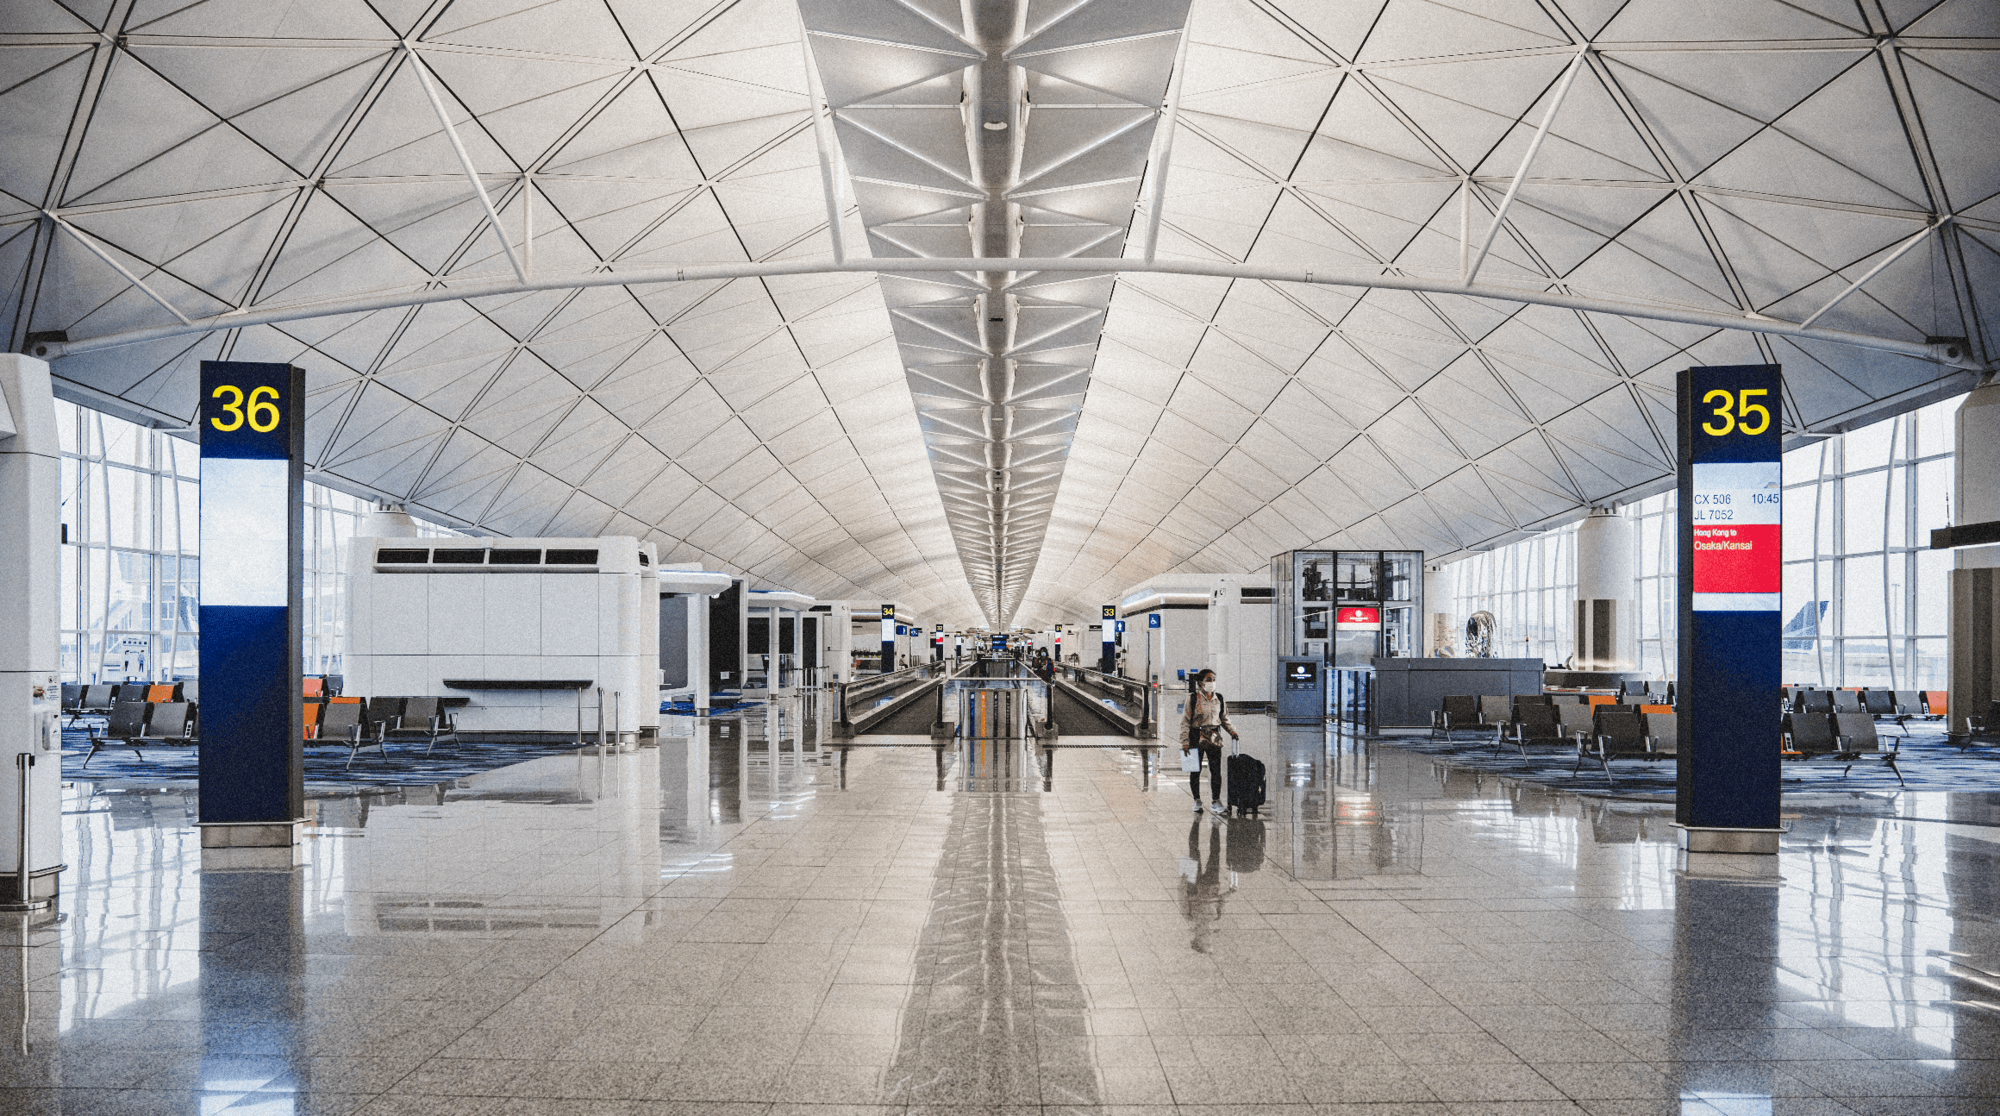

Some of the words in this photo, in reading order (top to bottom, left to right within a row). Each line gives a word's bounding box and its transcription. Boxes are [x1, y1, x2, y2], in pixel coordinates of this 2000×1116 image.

[210, 384, 280, 433] 36
[1702, 388, 1770, 436] 35
[1694, 494, 1709, 504] CX
[1713, 493, 1731, 504] 506
[1752, 493, 1779, 504] 10:45
[1694, 509, 1706, 520] JL
[1709, 509, 1733, 520] 7052
[1693, 529, 1711, 538] Hong
[1712, 529, 1729, 538] Kong
[1694, 540, 1752, 550] Osaka/Kansai
[882, 607, 894, 616] 34
[1103, 608, 1114, 616] 33
